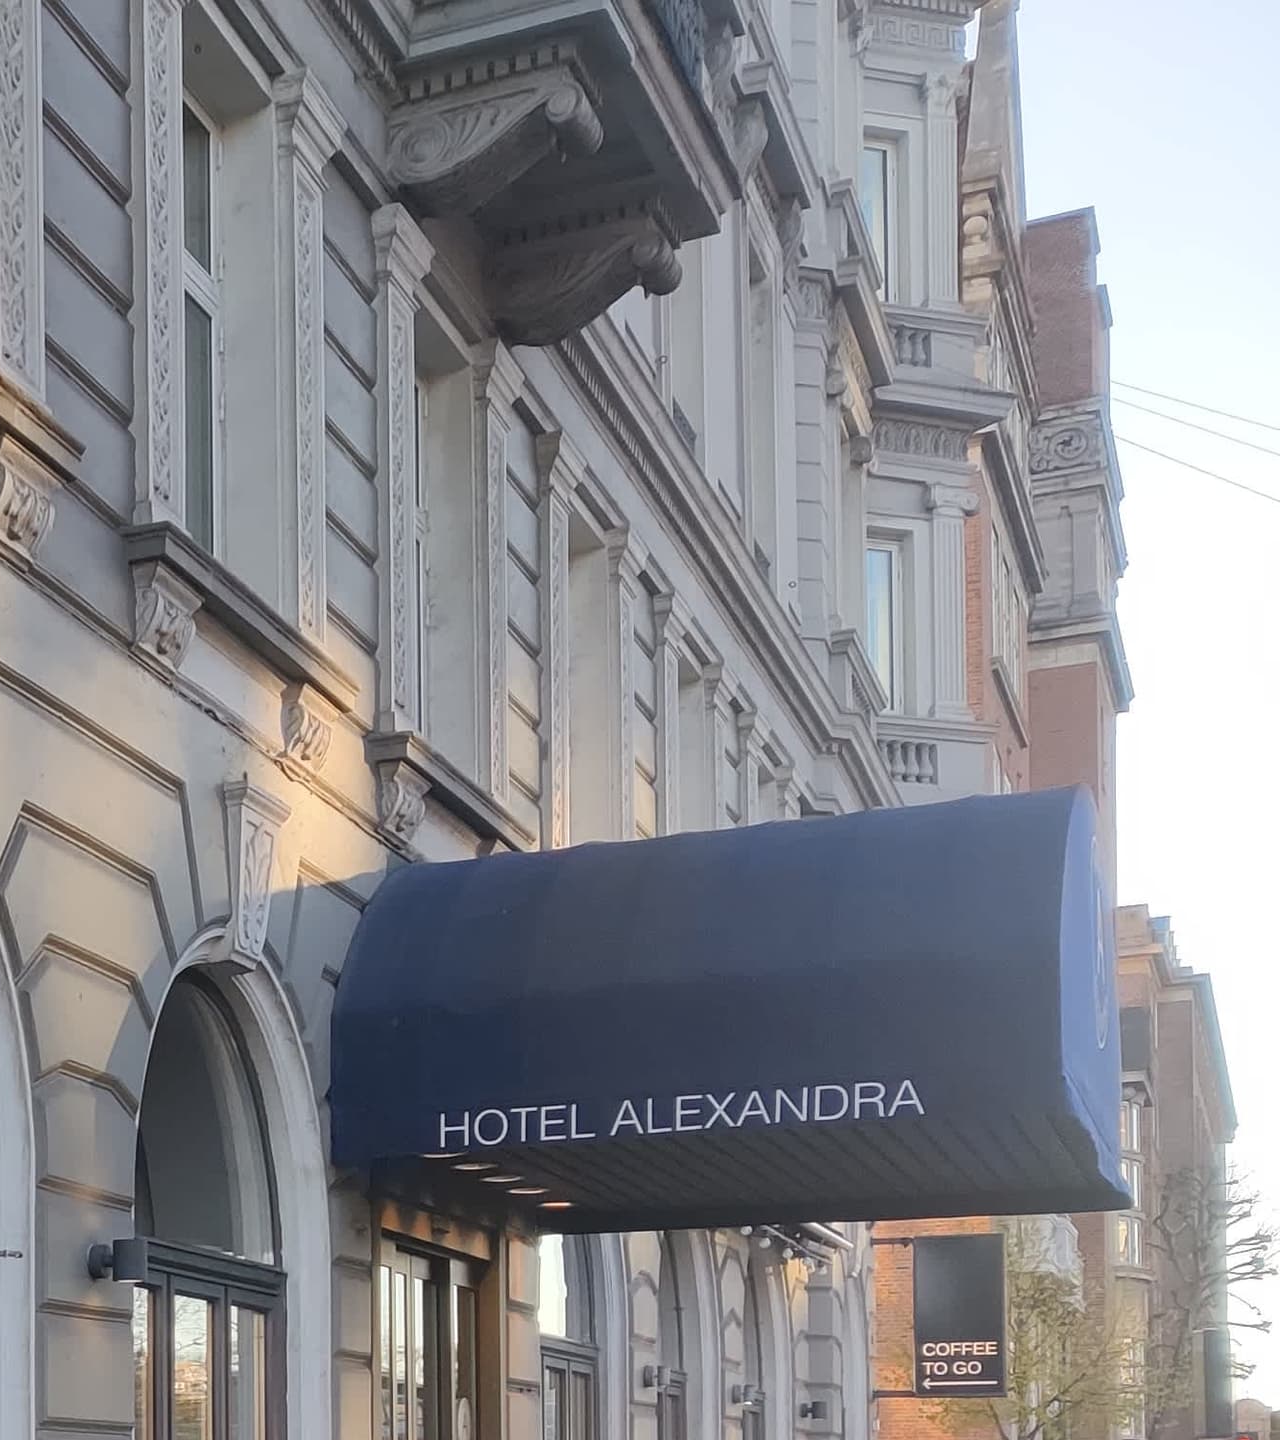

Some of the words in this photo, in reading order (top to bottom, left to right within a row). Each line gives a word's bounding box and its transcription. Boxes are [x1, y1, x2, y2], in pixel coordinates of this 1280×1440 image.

[440, 1103, 596, 1148] HOTEL
[609, 1079, 926, 1137] ALEXANDRA
[922, 1342, 998, 1356] COFFEE
[921, 1361, 948, 1375] TO
[953, 1361, 982, 1375] GO
